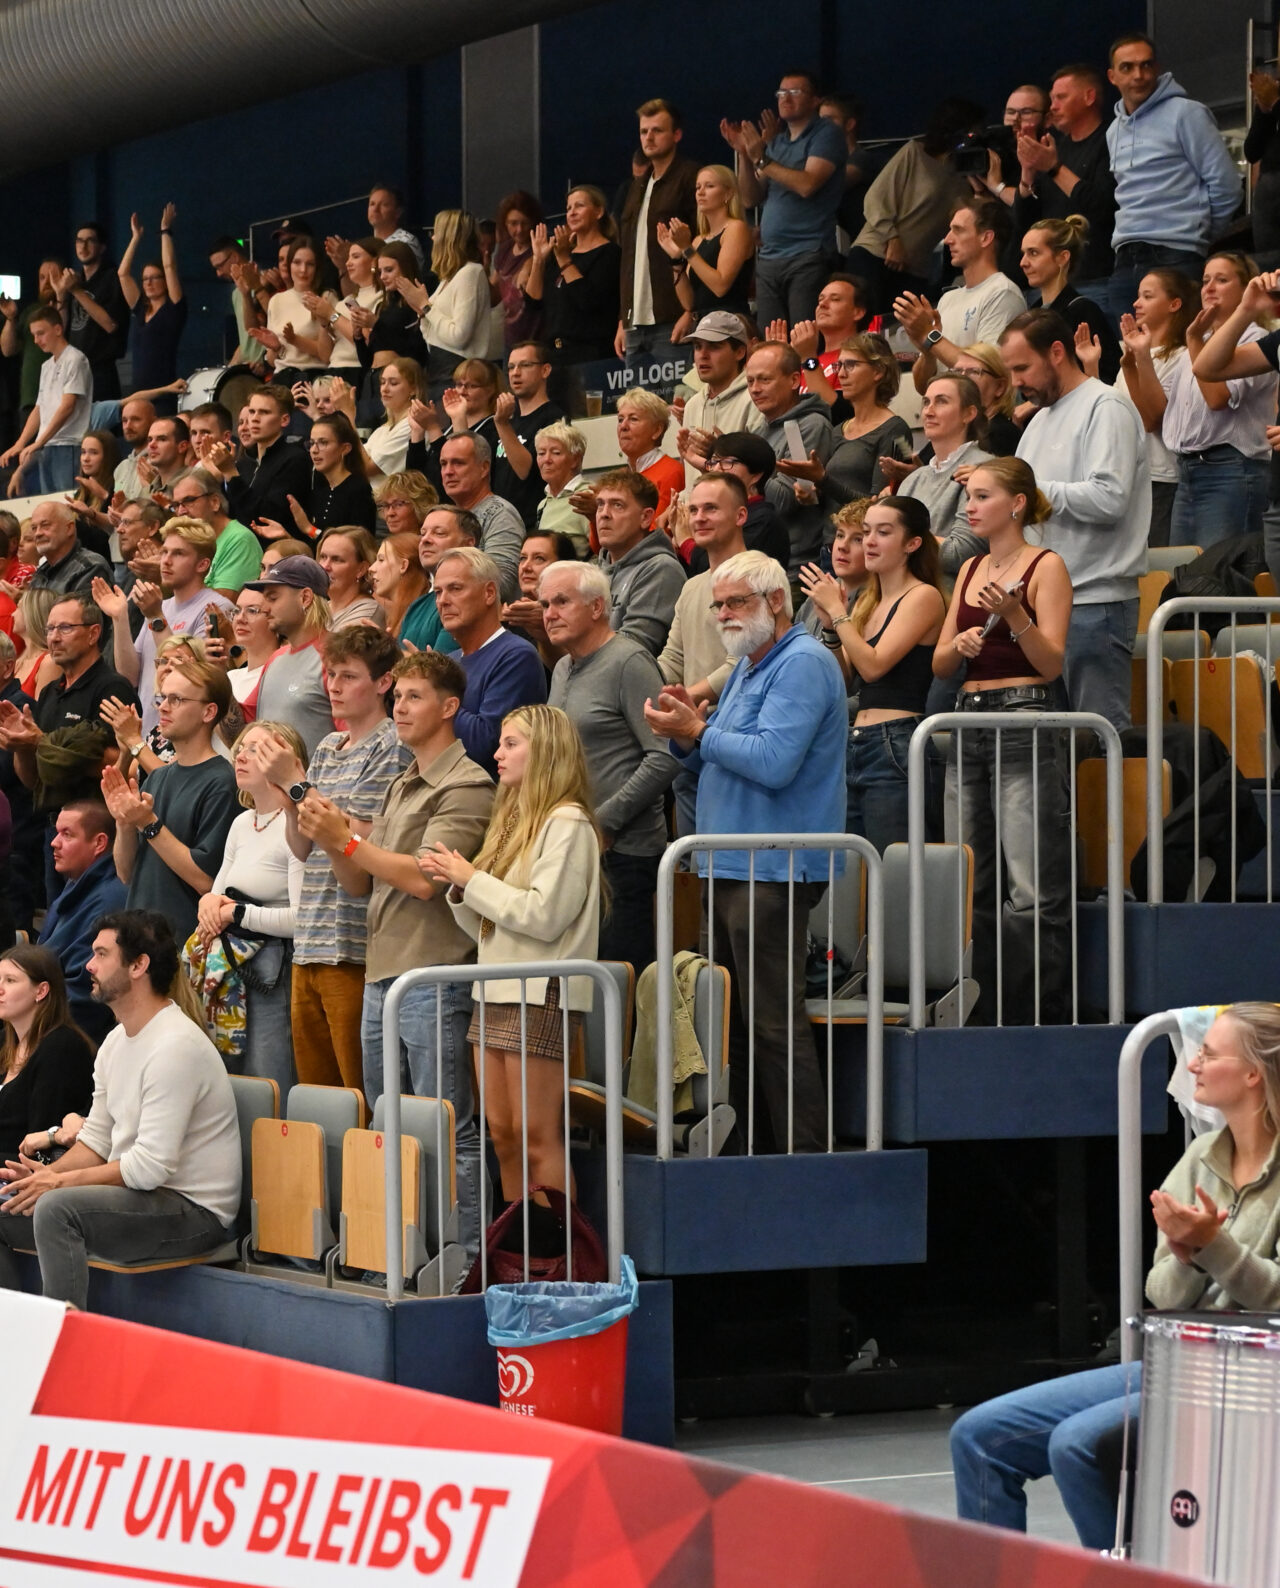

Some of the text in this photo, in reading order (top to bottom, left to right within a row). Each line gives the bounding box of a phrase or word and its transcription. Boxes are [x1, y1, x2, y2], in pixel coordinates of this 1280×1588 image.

[606, 360, 686, 390] VIP LOGE
[15, 1444, 510, 1580] MIT UNS BLEIBST
